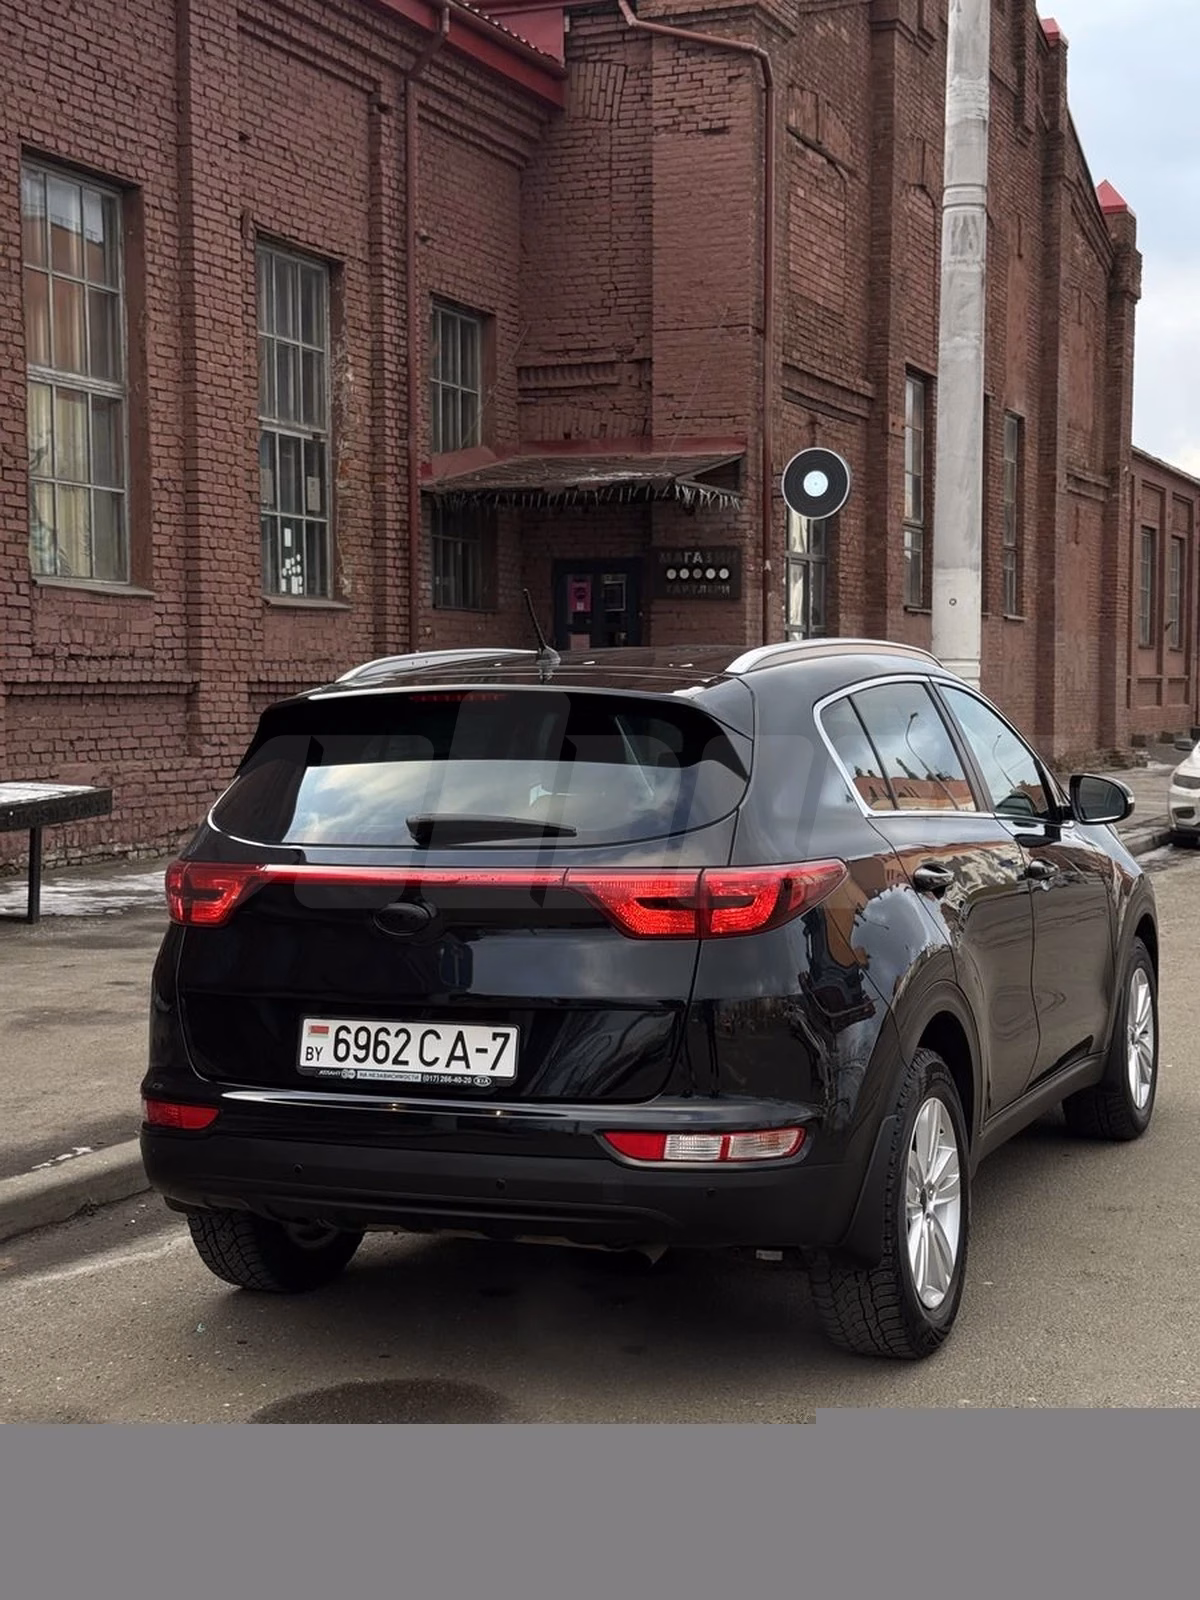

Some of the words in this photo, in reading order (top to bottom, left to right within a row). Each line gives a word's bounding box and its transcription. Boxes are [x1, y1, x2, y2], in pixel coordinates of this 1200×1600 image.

[305, 1046, 323, 1062] BY
[333, 1025, 411, 1066] 6962
[418, 1029, 511, 1071] CA-7
[423, 1074, 440, 1083] (017)
